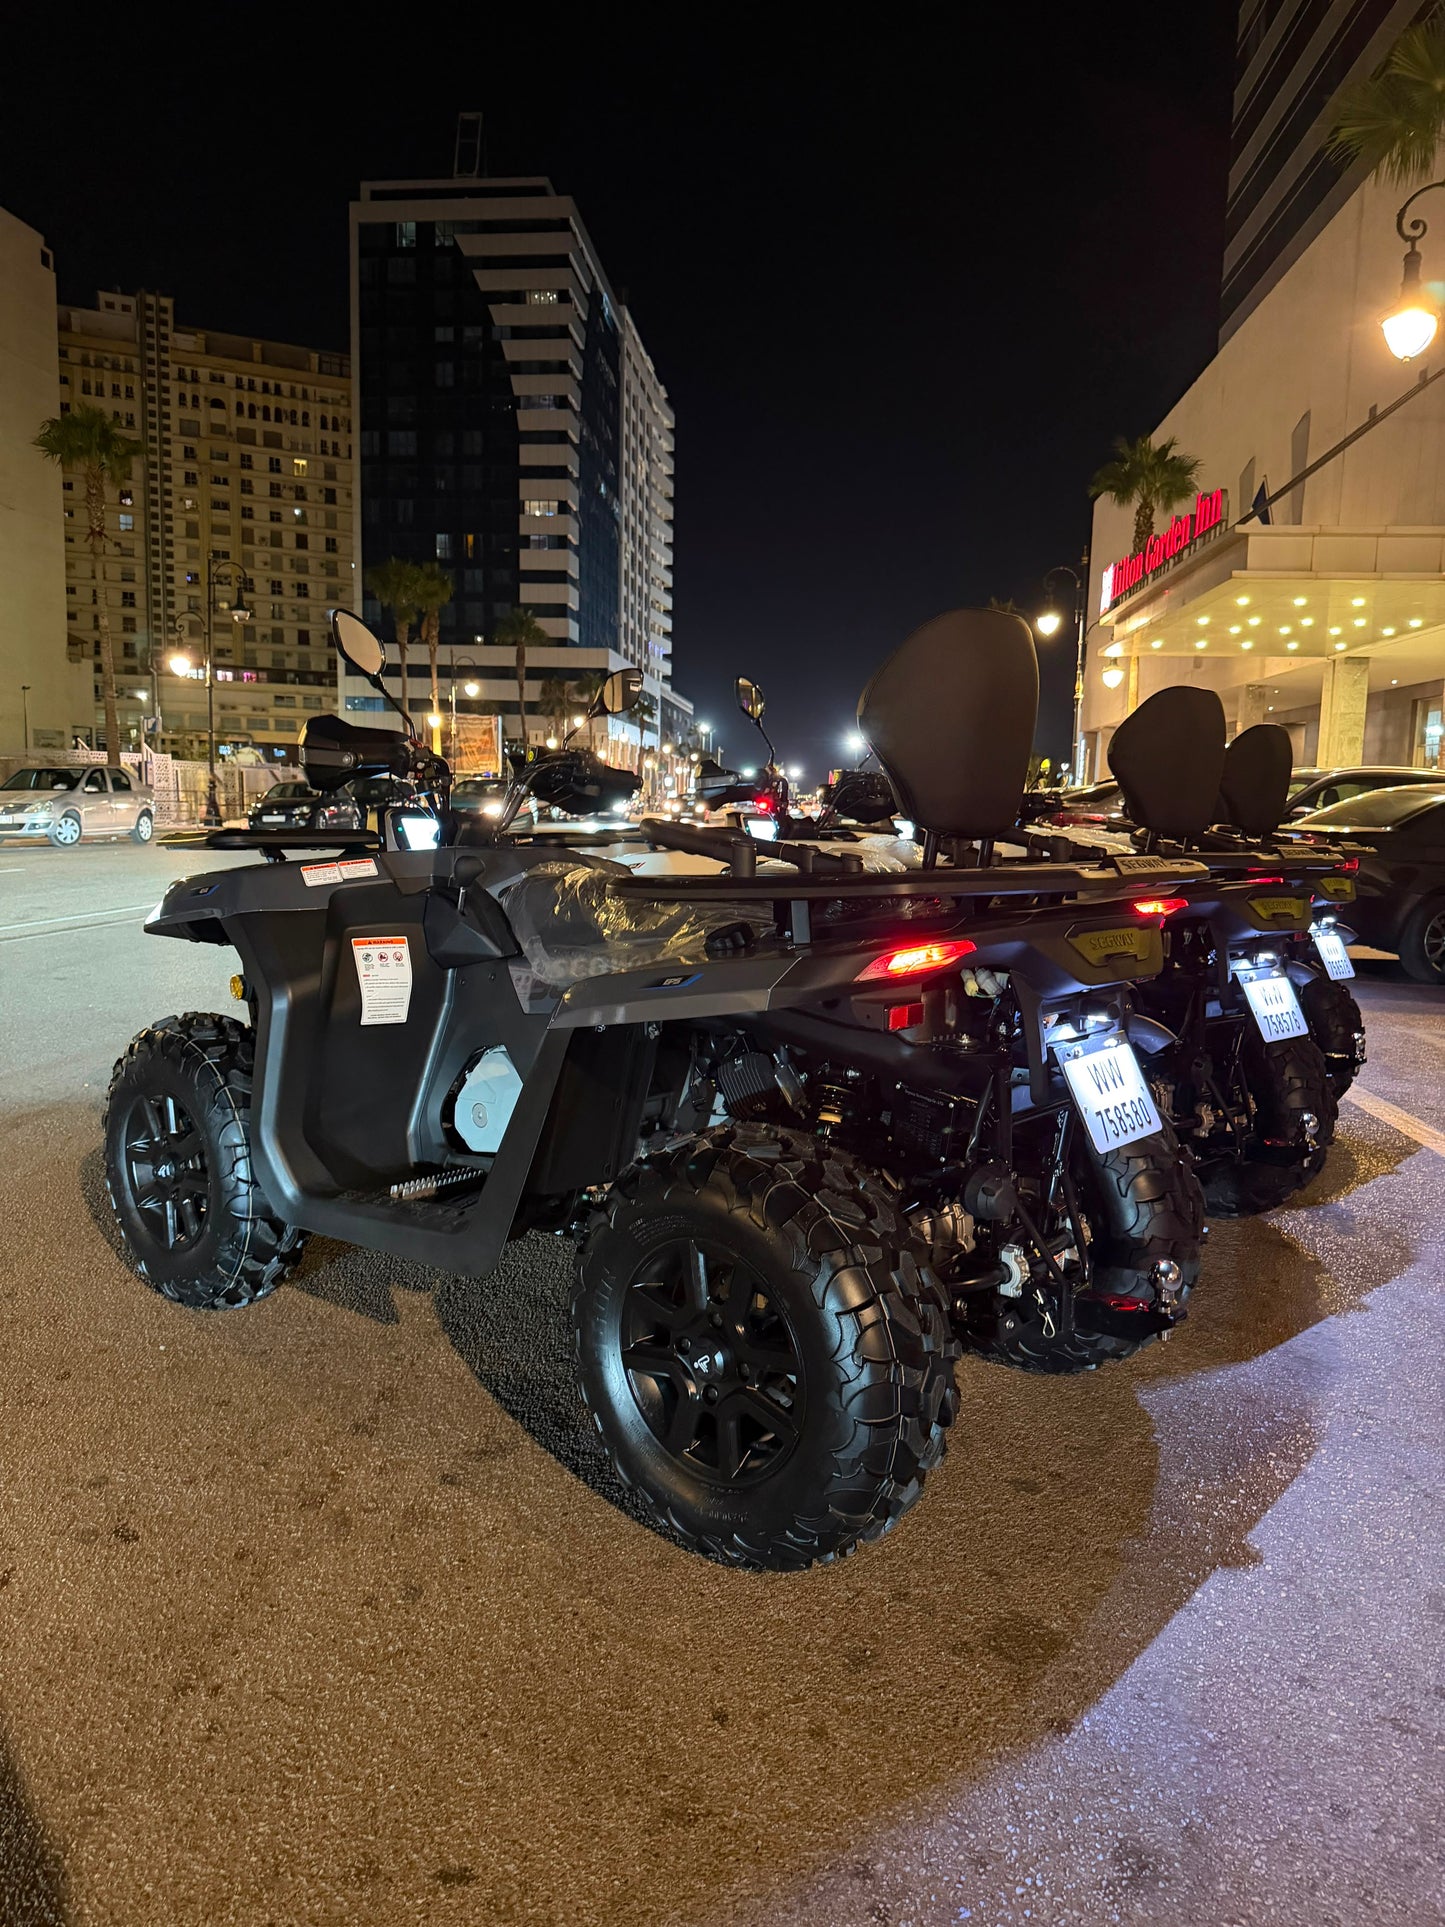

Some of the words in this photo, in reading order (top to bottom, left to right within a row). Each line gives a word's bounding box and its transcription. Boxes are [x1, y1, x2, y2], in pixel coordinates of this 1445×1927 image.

[1110, 551, 1143, 600] Hilton
[1145, 514, 1190, 575] Garden
[1193, 488, 1222, 539] Inn
[1120, 859, 1168, 871] SEGWAY
[1089, 932, 1134, 950] SEGWAY
[1263, 1010, 1301, 1036] 758576
[1086, 1056, 1125, 1095] WW
[1095, 1096, 1152, 1143] 758580
